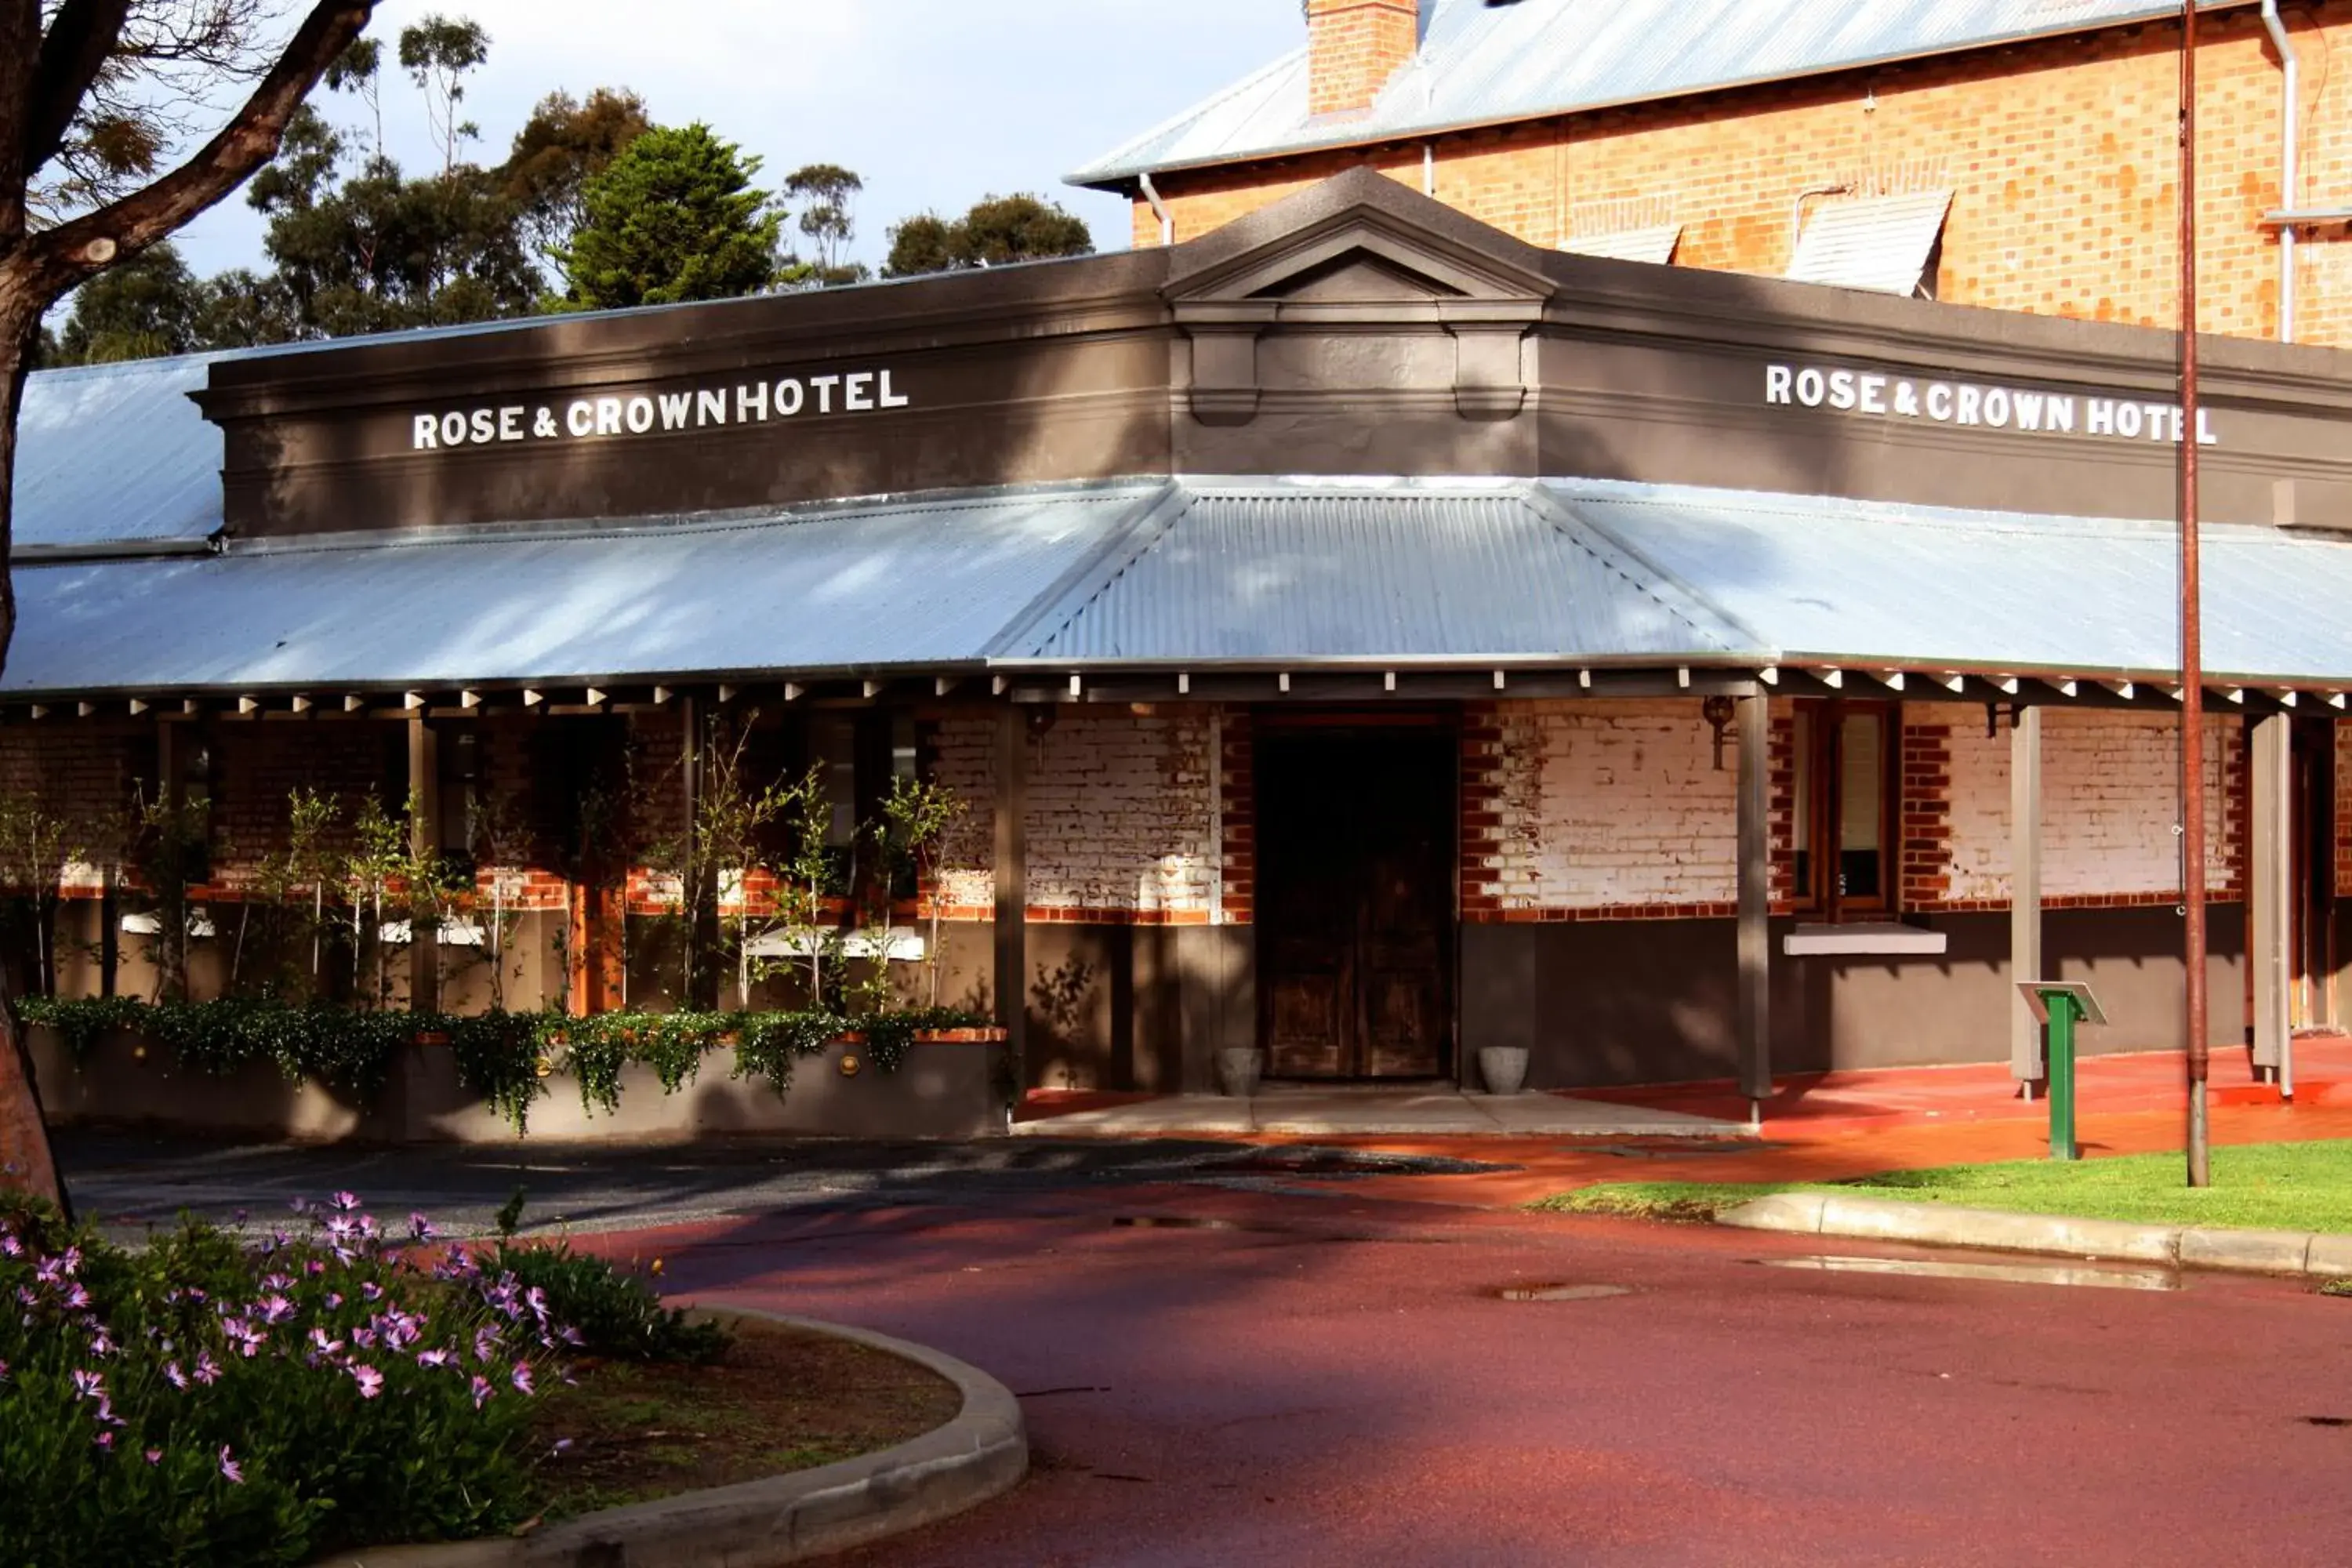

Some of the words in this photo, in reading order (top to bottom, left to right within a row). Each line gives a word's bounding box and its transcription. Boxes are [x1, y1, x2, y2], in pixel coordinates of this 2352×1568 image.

[413, 406, 524, 449] ROSE
[533, 406, 558, 437] &
[567, 388, 726, 437] CROWN
[736, 369, 909, 423] HOTEL
[1766, 365, 1888, 414] ROSE
[1893, 381, 1920, 416] &
[1926, 383, 2074, 432] CROWN
